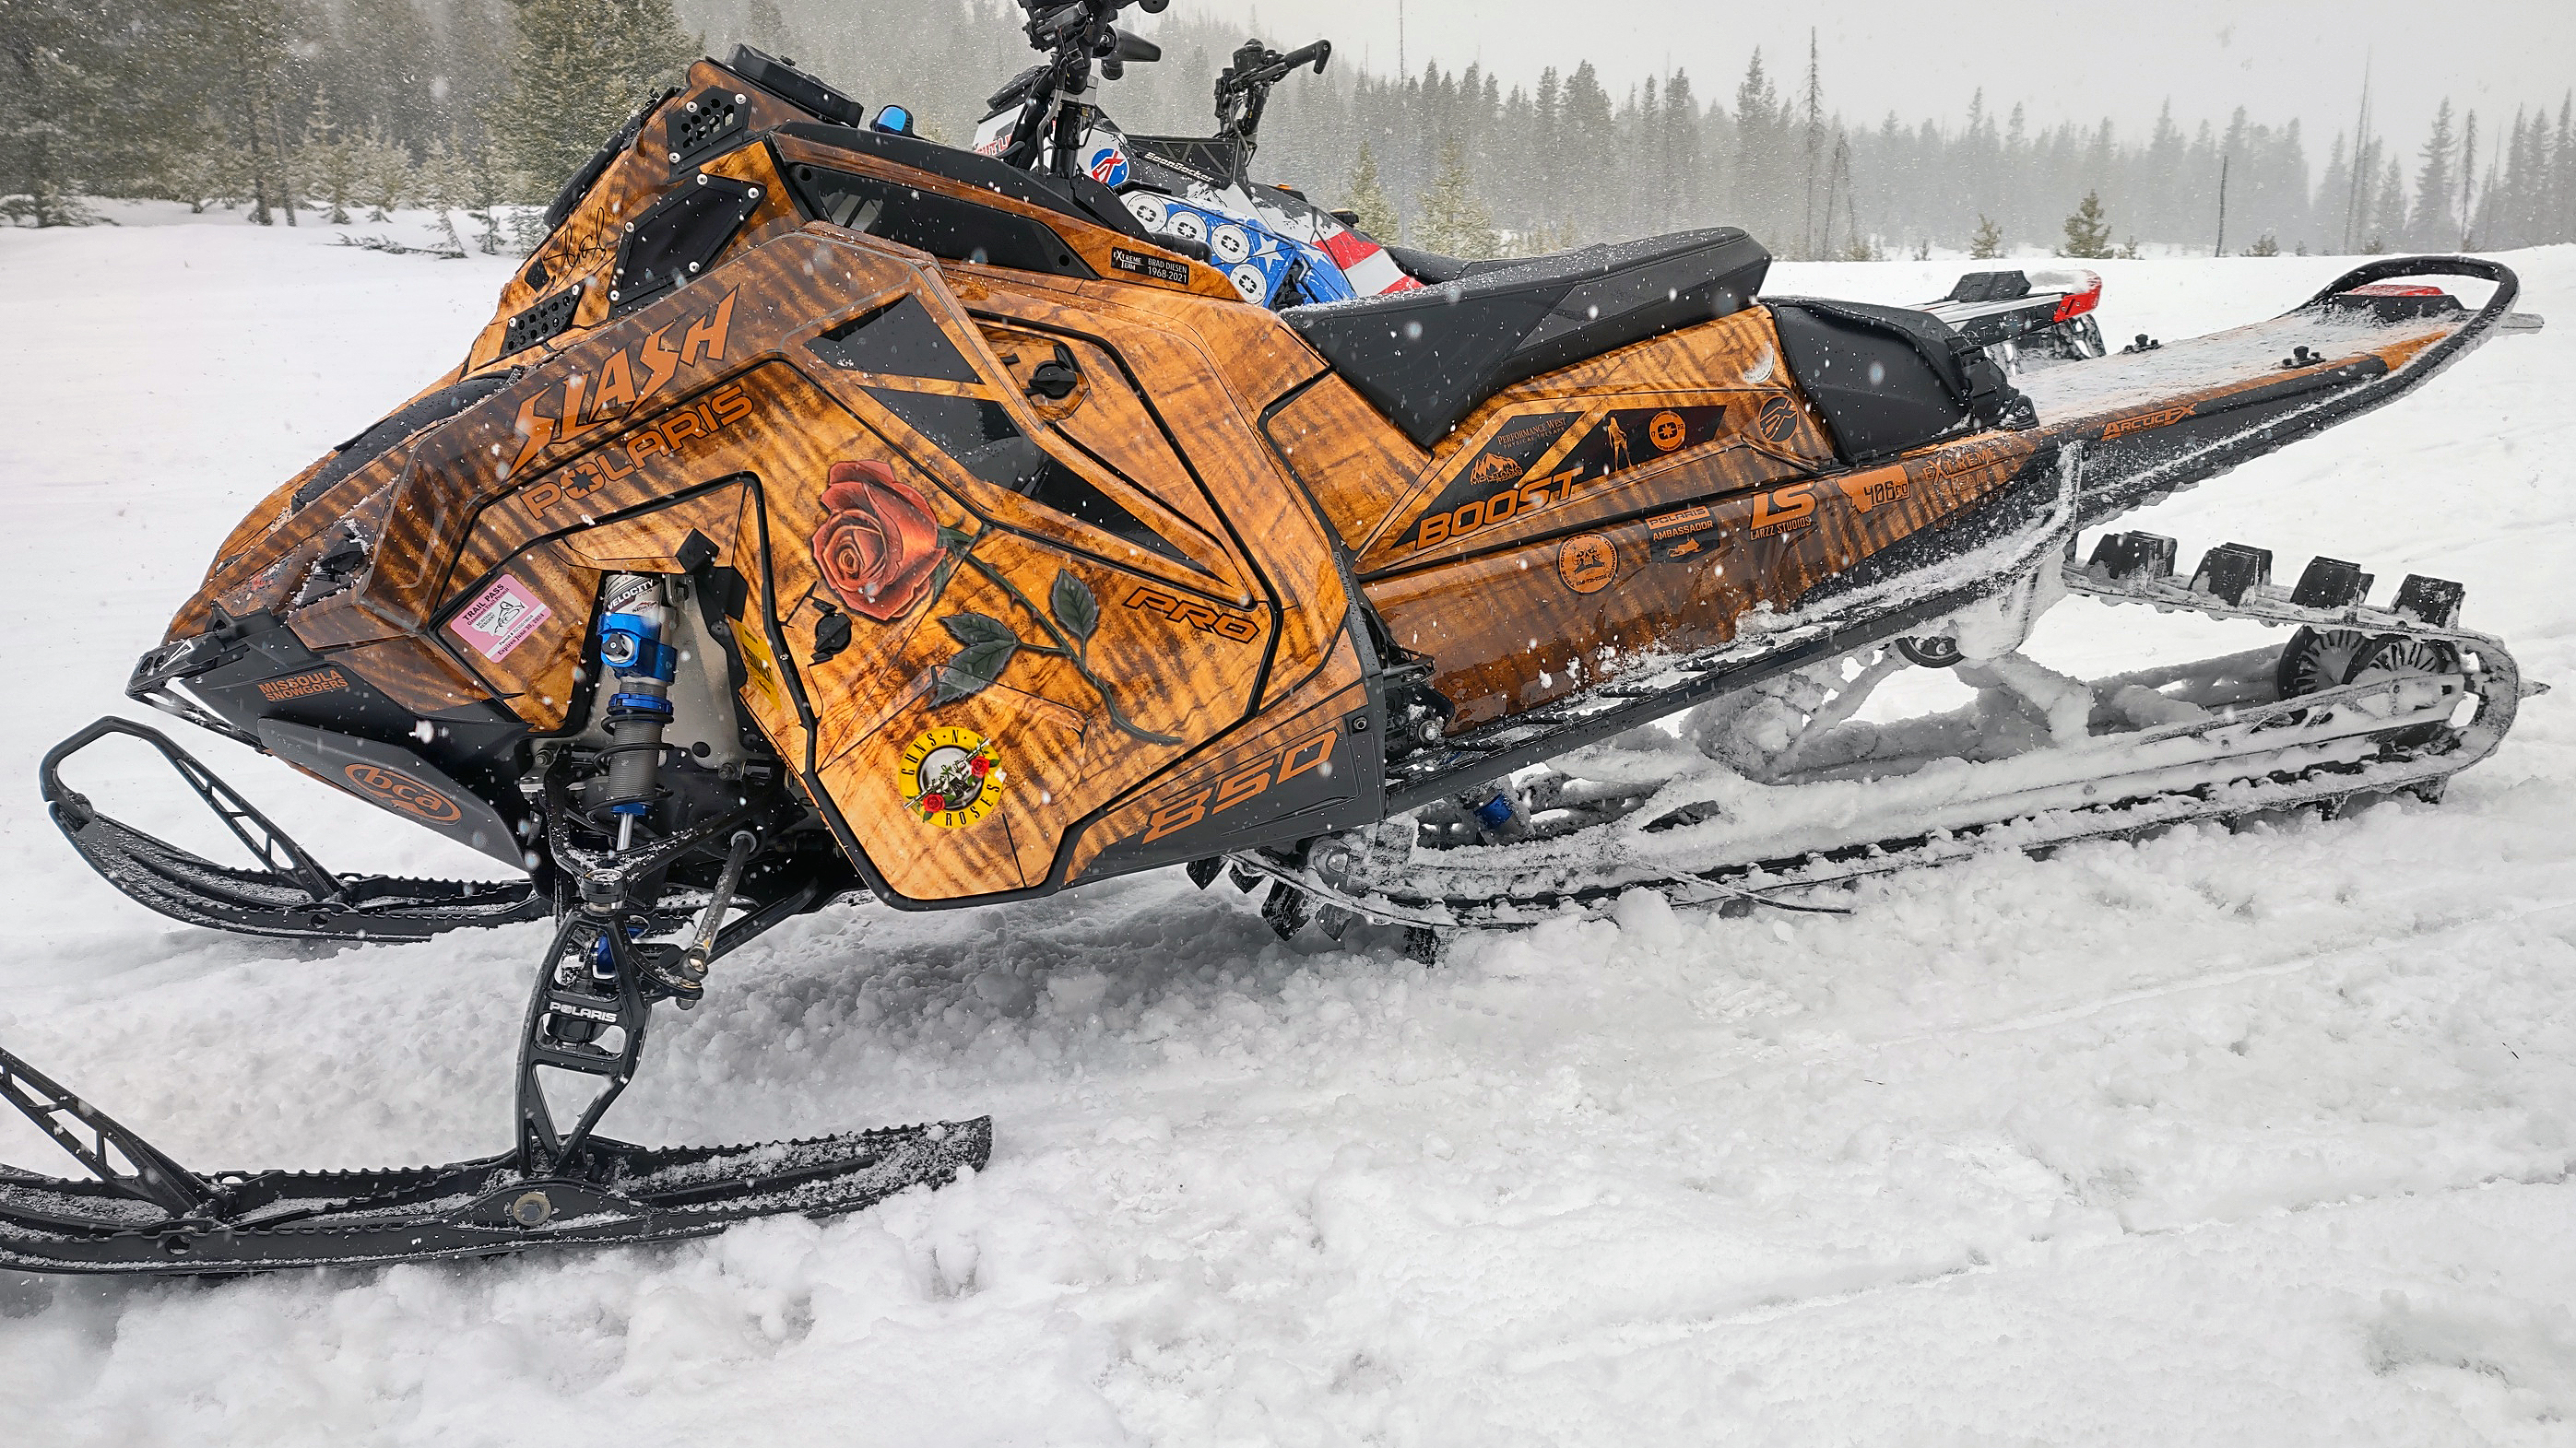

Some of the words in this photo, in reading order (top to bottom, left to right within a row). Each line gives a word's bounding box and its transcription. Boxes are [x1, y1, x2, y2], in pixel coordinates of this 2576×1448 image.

[1120, 261, 1136, 271] TEAM
[1148, 258, 1164, 268] BRAD
[1165, 262, 1188, 274] DIESEN
[1148, 266, 1187, 284] 1968-2021
[508, 282, 741, 481] SLASH
[1497, 424, 1547, 445] PERFORMANCE
[1546, 418, 1567, 430] WEST
[519, 383, 754, 520] POLARIS
[1948, 470, 1989, 497] TEAM
[1414, 466, 1585, 550] BOOST
[1648, 508, 1707, 527] POLARIS
[1751, 481, 1818, 531] LS
[1652, 519, 1714, 541] AMBASSADOR
[1751, 526, 1776, 541] LARZZ
[1777, 516, 1813, 536] STUDIOS
[462, 601, 487, 622] TRAIL
[484, 583, 504, 602] PASS
[495, 587, 510, 601] Permit
[608, 578, 654, 611] VELOCITY
[1121, 586, 1261, 644] PRO
[498, 639, 516, 655] Expires
[499, 634, 513, 646] Permit
[258, 669, 344, 694] MISSOULA
[265, 678, 349, 701] SNOWGOERS
[901, 732, 937, 776] GUNS
[363, 768, 443, 811] bca
[1141, 728, 1338, 845] 850
[945, 783, 1000, 827] ROSES
[549, 1001, 618, 1023] POLARIS
